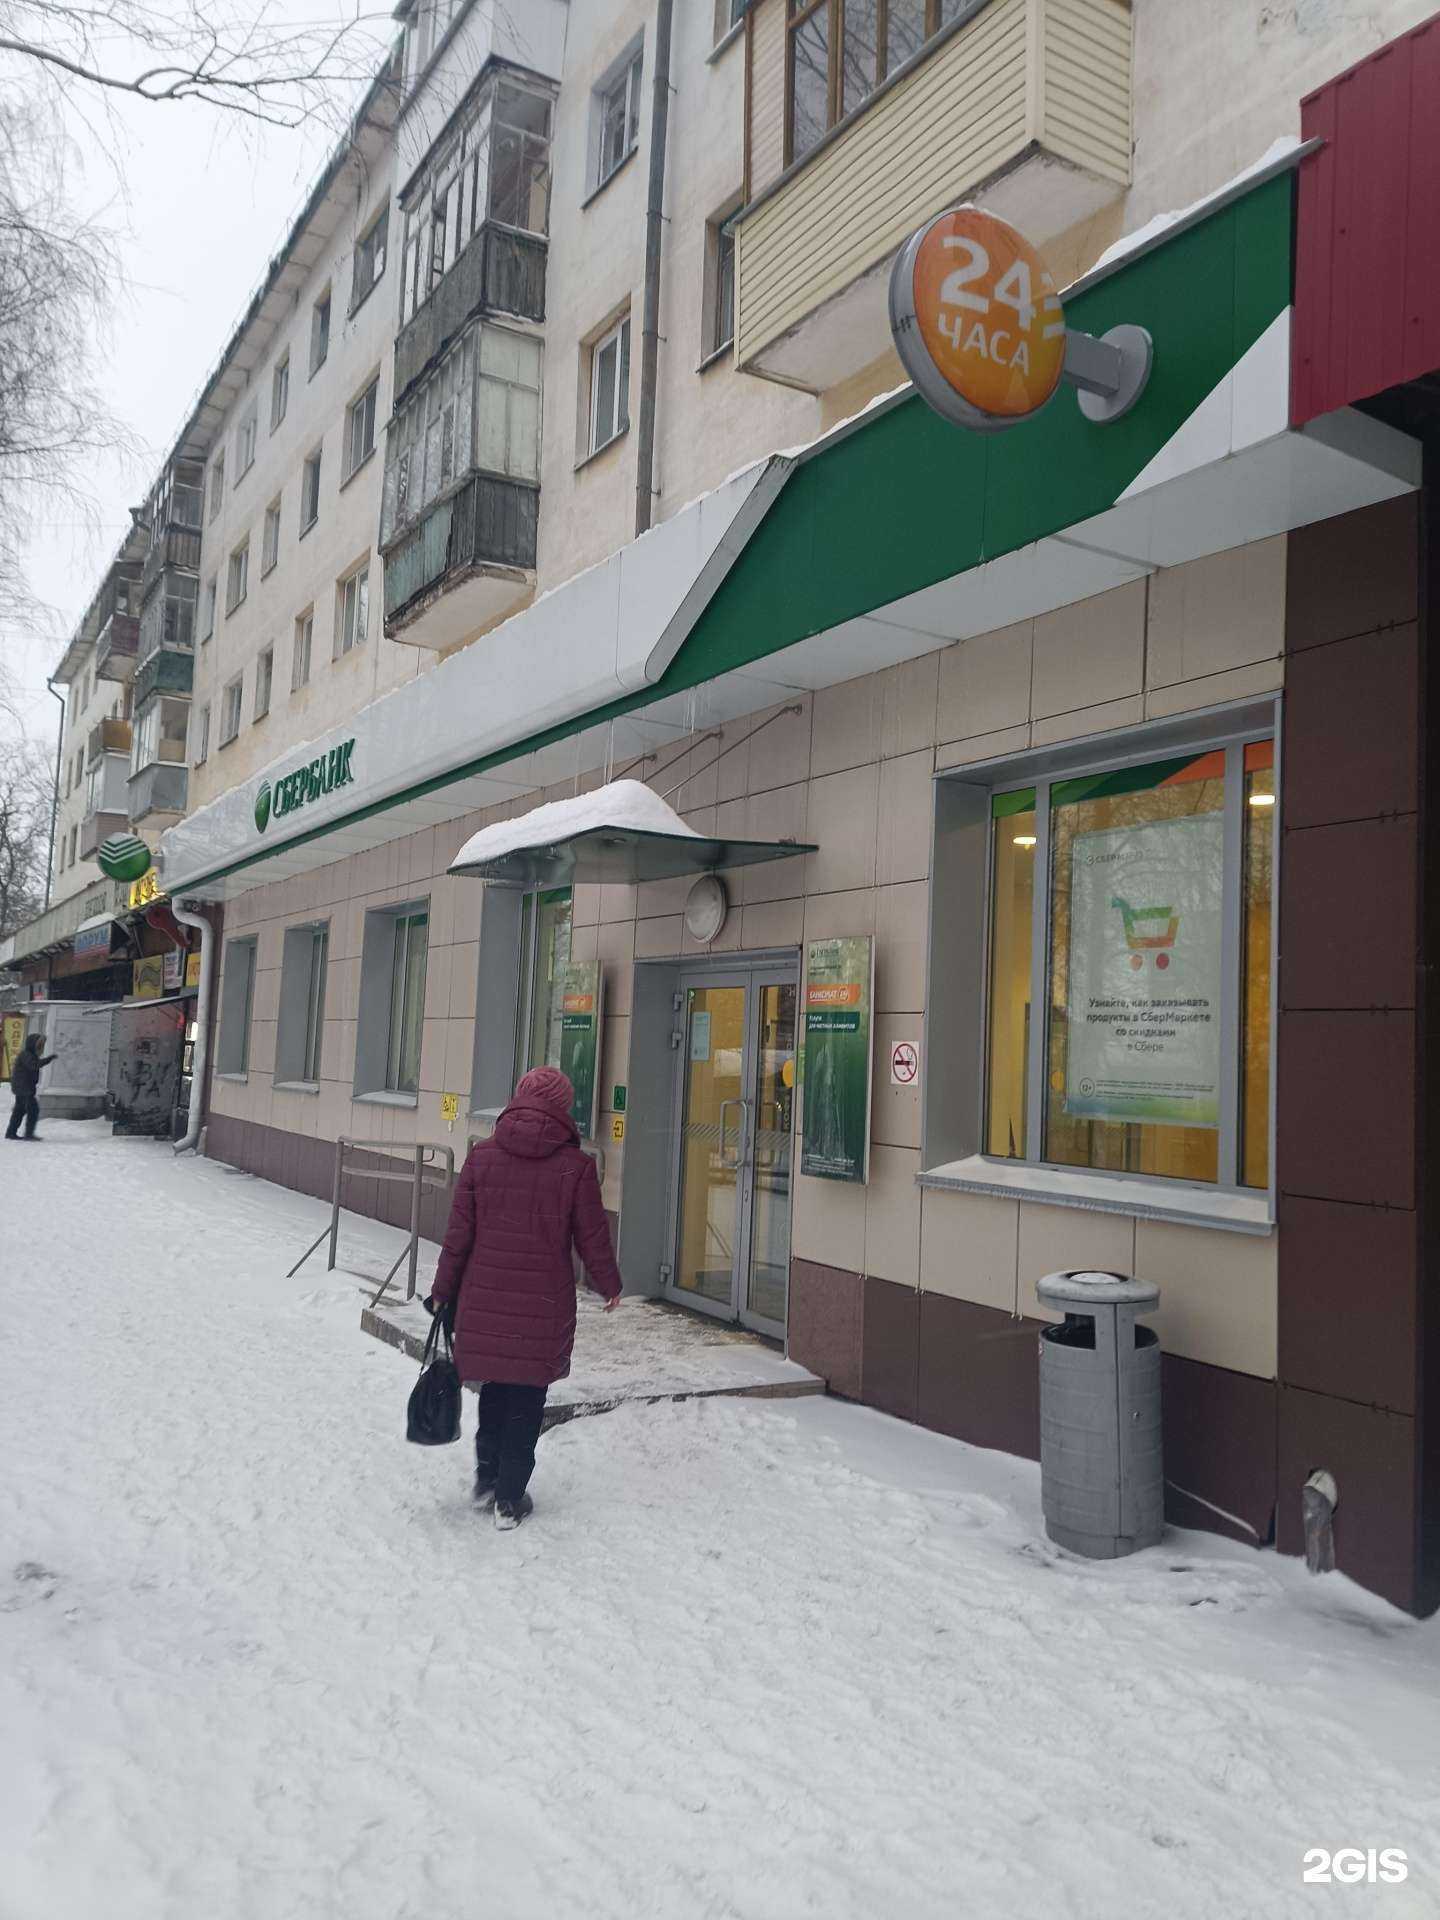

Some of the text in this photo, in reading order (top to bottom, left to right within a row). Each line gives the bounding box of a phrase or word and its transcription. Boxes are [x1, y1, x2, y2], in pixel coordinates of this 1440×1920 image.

[940, 236, 1037, 332] 24
[937, 313, 1030, 377] ЧАСА
[272, 738, 355, 819] СБЕРБАНК
[1115, 1028, 1127, 1036] со
[1141, 1011, 1211, 1024] СберМаркете
[1134, 1041, 1164, 1052] Сбере
